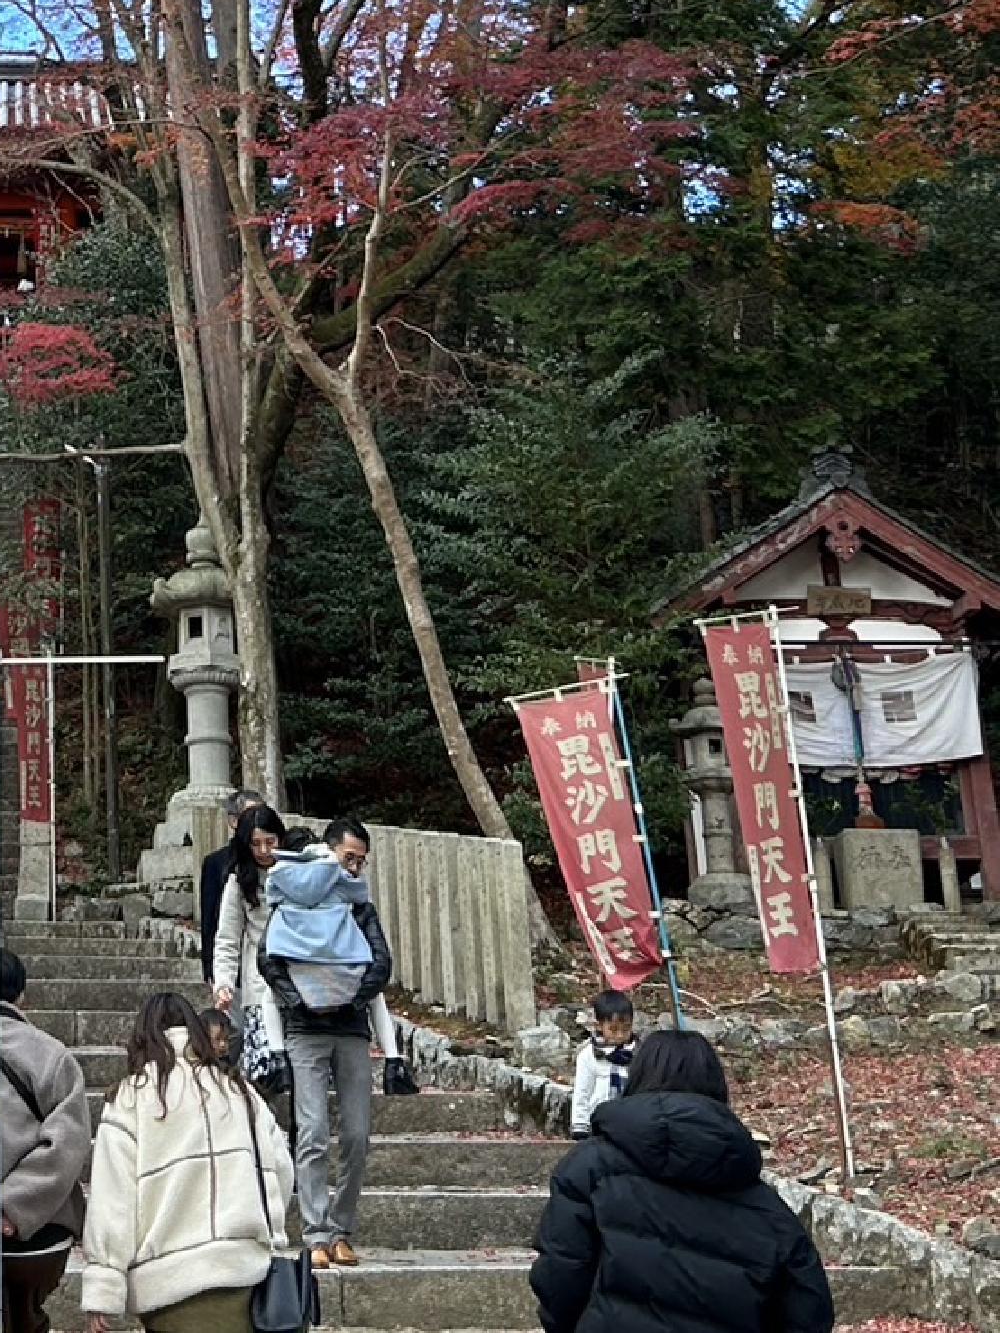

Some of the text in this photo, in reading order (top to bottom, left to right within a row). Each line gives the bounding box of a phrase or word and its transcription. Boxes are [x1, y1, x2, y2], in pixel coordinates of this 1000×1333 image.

[540, 711, 597, 737] 奉納
[733, 672, 799, 938] 毘沙門天王
[556, 734, 644, 962] 毘沙門天王
